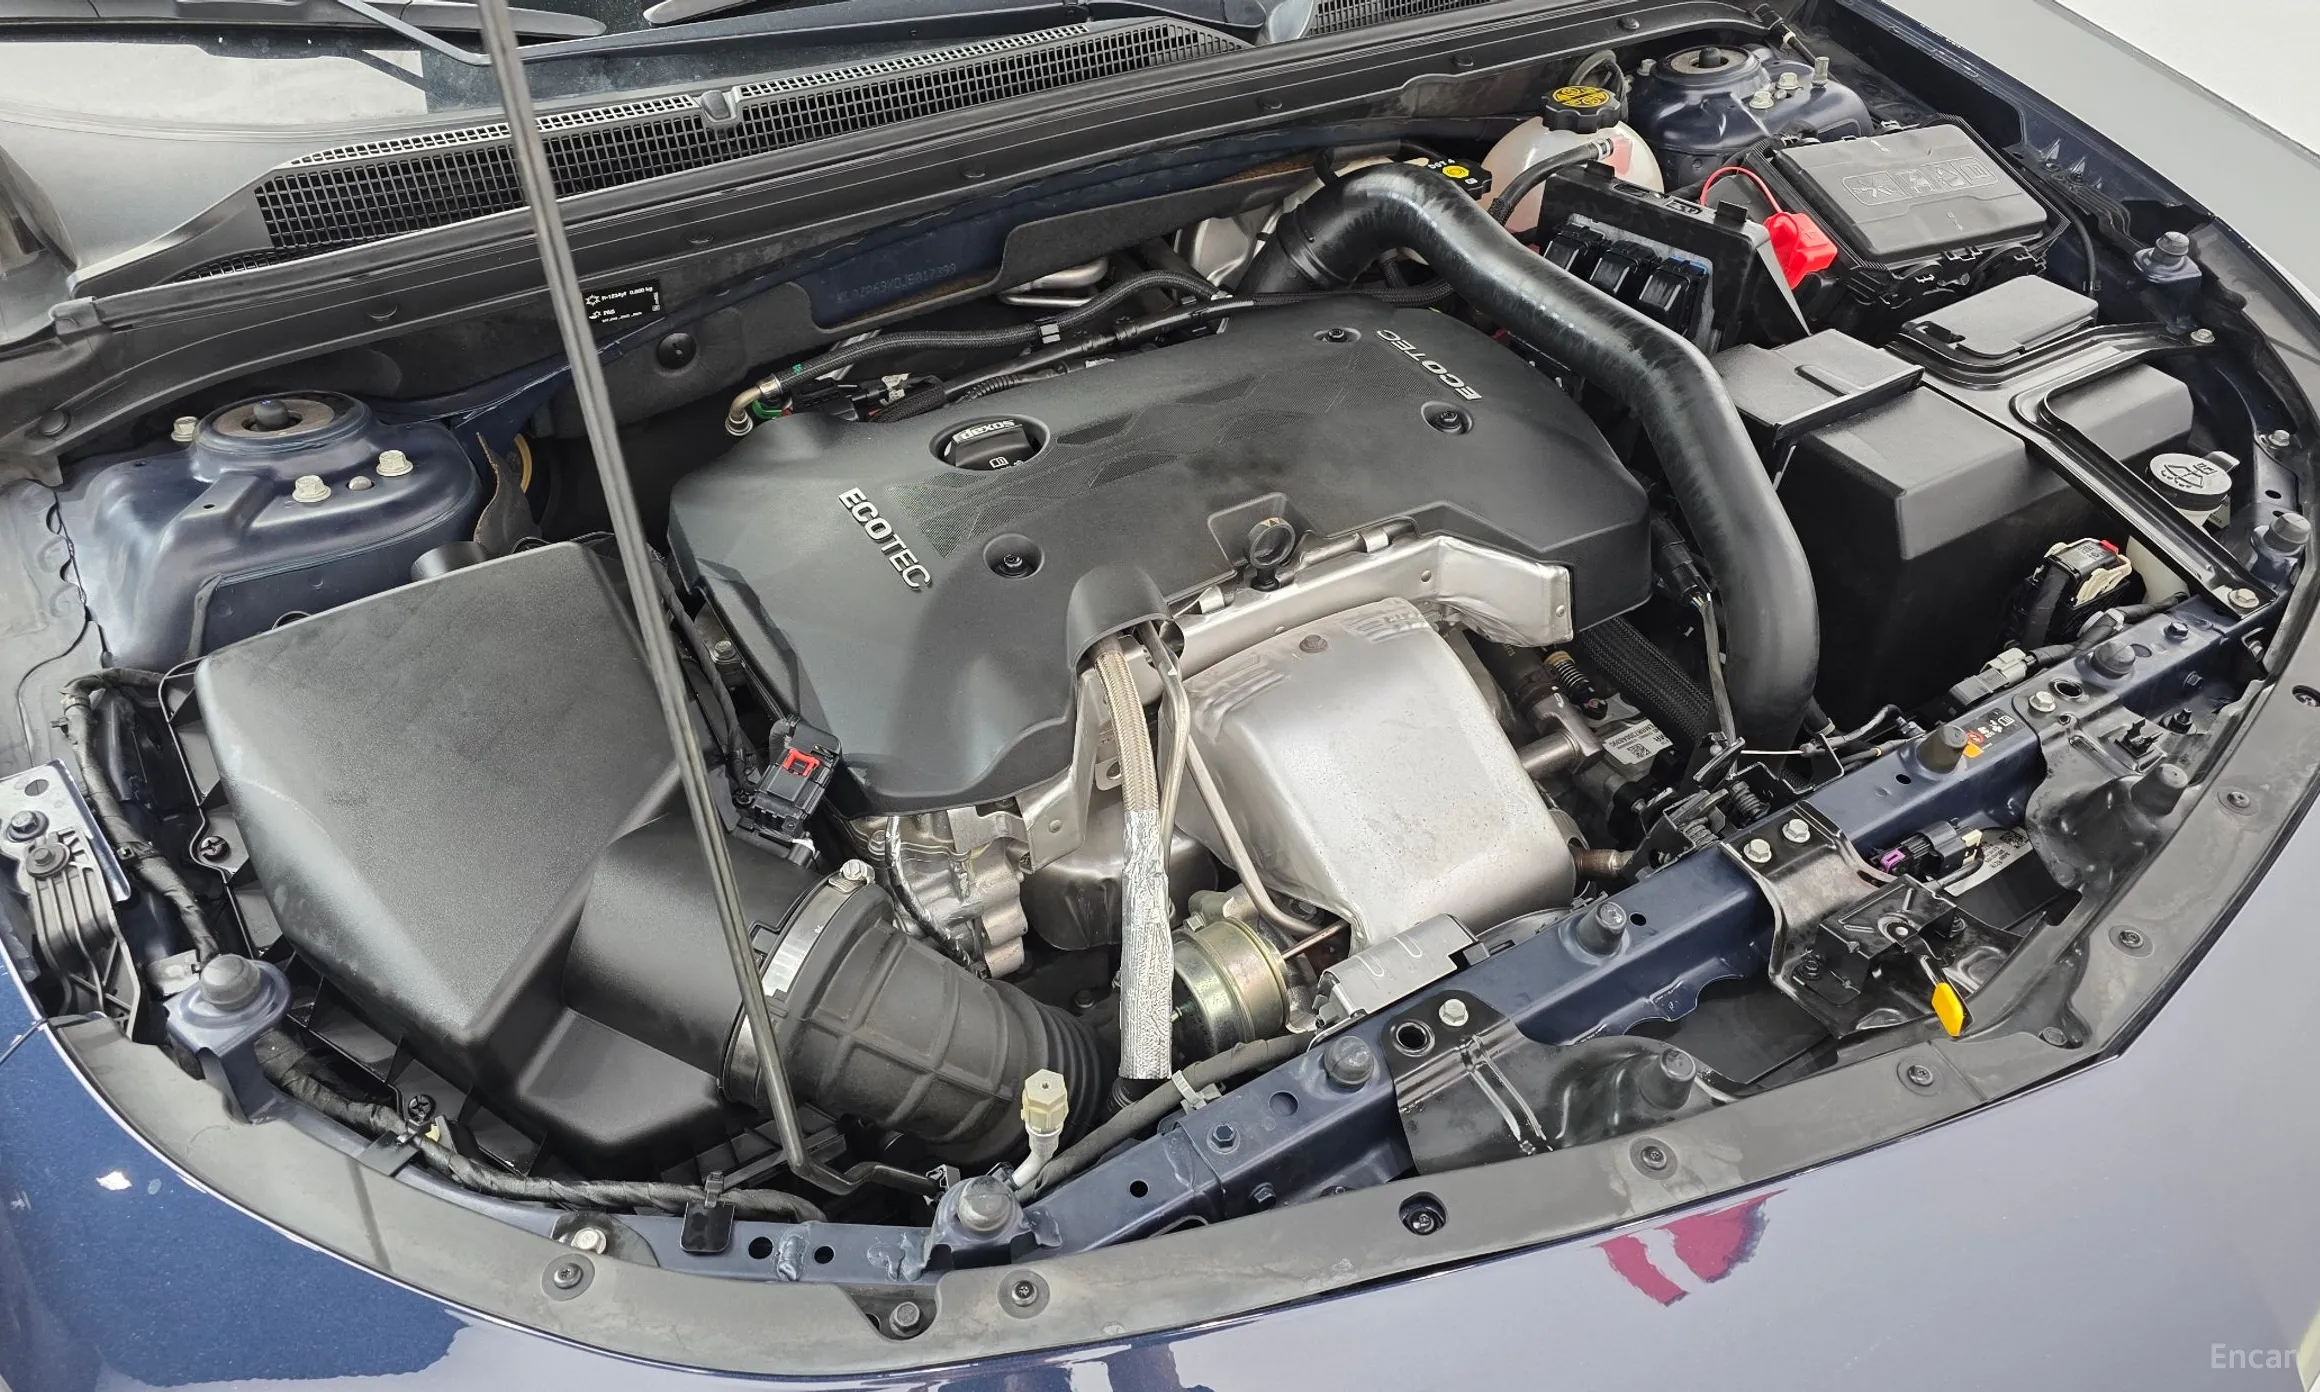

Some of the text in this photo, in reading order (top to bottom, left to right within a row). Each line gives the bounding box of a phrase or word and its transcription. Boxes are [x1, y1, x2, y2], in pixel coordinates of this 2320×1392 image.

[1376, 329, 1483, 400] ECOTEC
[960, 419, 1016, 440] dexos
[838, 487, 931, 588] ECOTEC
